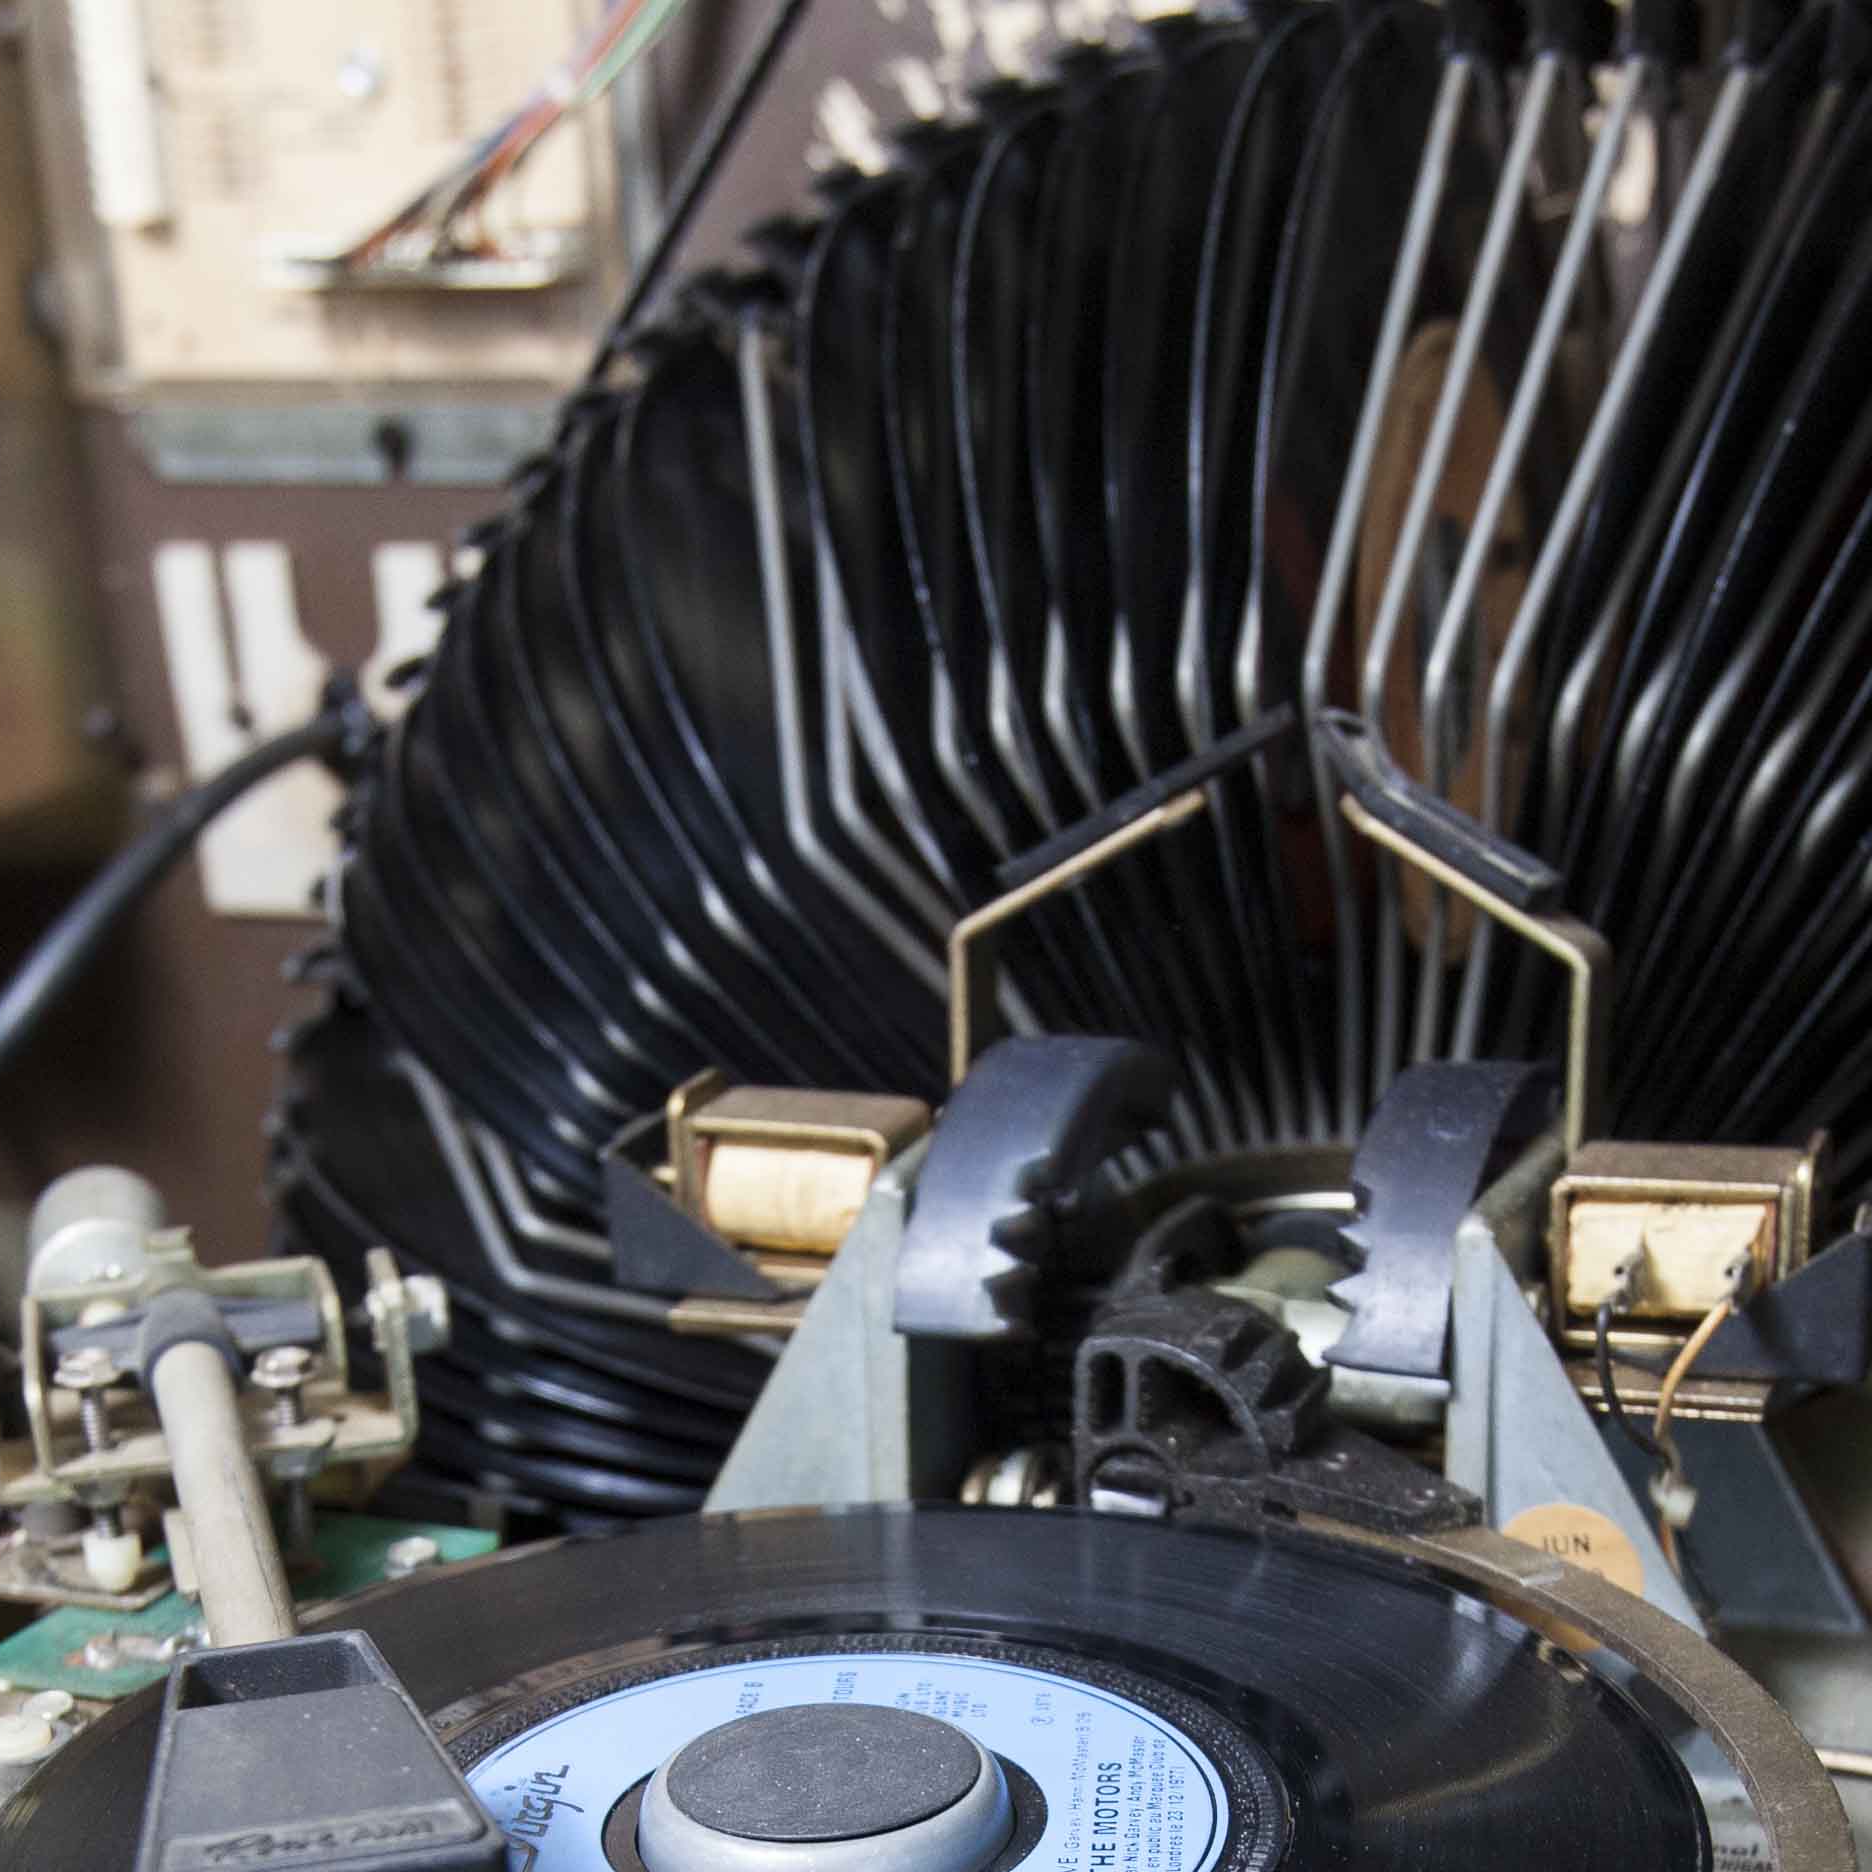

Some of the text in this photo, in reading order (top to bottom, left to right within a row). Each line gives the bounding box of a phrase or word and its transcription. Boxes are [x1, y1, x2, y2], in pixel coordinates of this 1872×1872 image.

[1092, 1760, 1123, 1835] MOTORS
[1121, 1841, 1140, 1861] Nick
[1164, 1834, 1184, 1872] Londres
